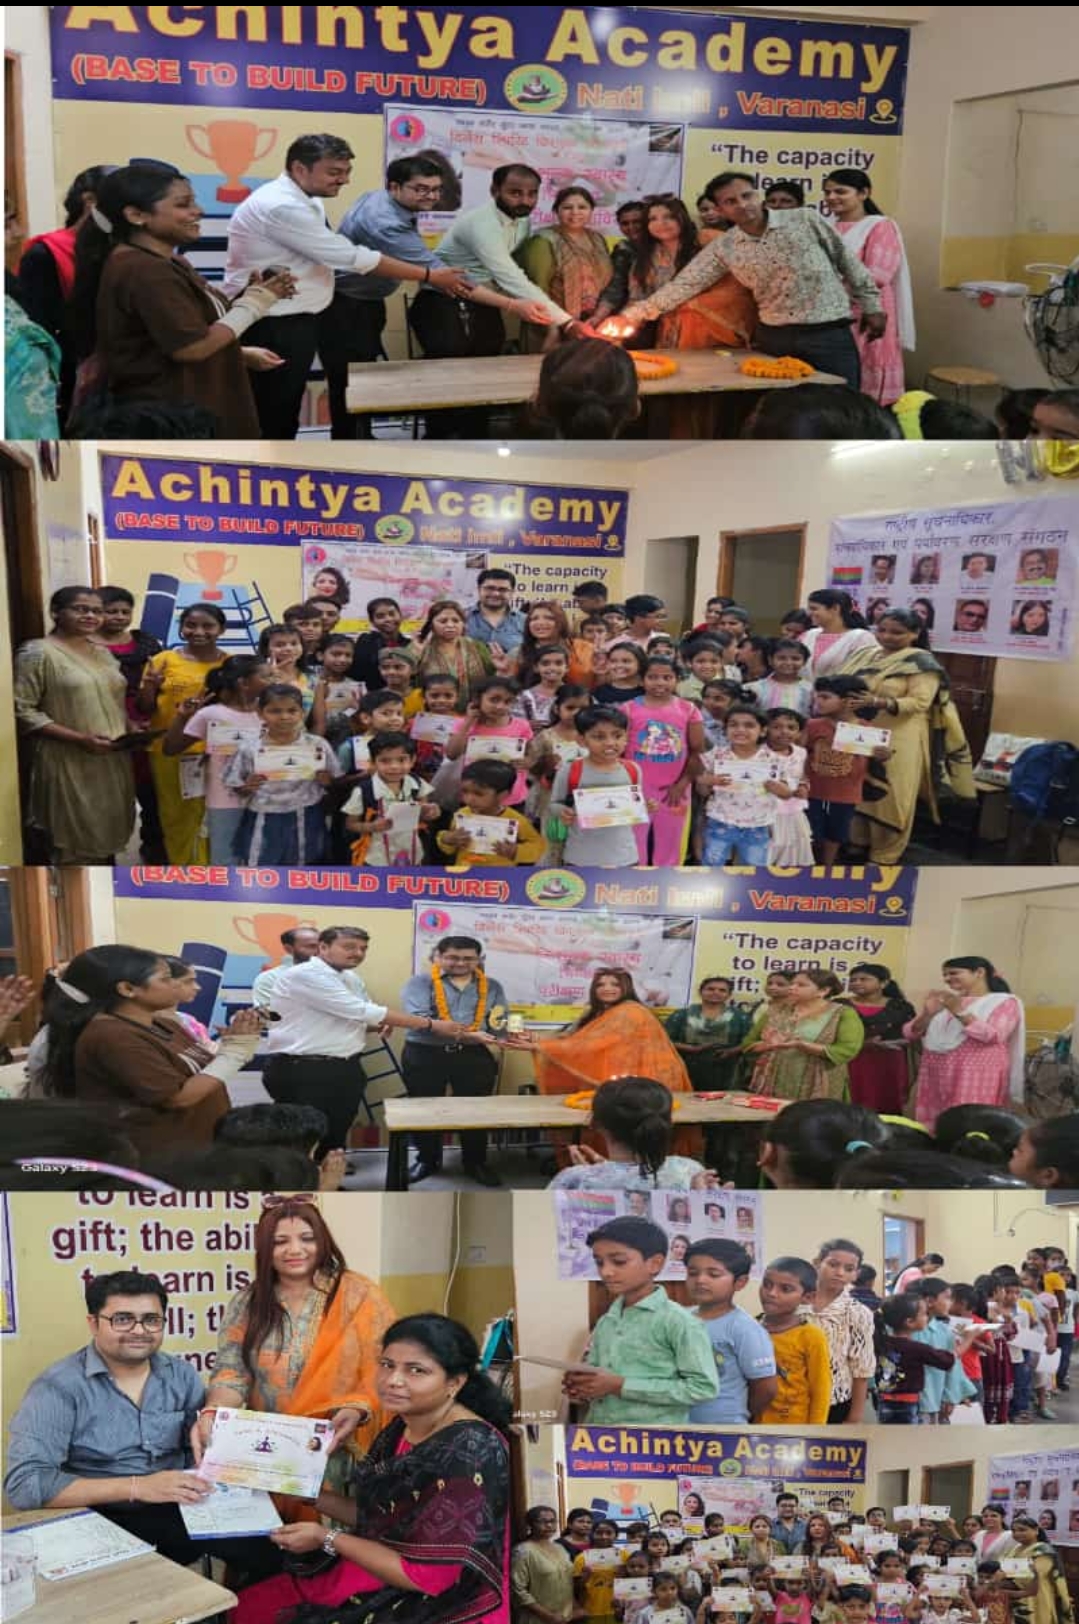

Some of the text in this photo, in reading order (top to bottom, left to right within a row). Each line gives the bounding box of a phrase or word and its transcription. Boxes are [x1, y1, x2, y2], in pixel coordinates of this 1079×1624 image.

[547, 9, 898, 92] Academy
[71, 53, 486, 105] (BASE TO BUILD FUTURE)
[736, 90, 866, 120] Varanasi
[777, 147, 875, 169] capacity
[112, 458, 622, 531] Achintya Academy
[115, 513, 181, 532] (BASE
[185, 514, 215, 532] TO
[219, 516, 280, 534] BUILD
[545, 565, 608, 579] capacity
[531, 580, 569, 593] learn
[130, 866, 511, 901] (BASE TO BUILD FUTURE)
[750, 889, 875, 914] Varanasi
[787, 936, 883, 953] capacity
[733, 955, 847, 972] to learn is
[52, 1220, 126, 1260] gift;
[140, 1222, 194, 1252] the
[226, 1264, 250, 1292] is
[571, 1428, 863, 1468] Achintya Academy
